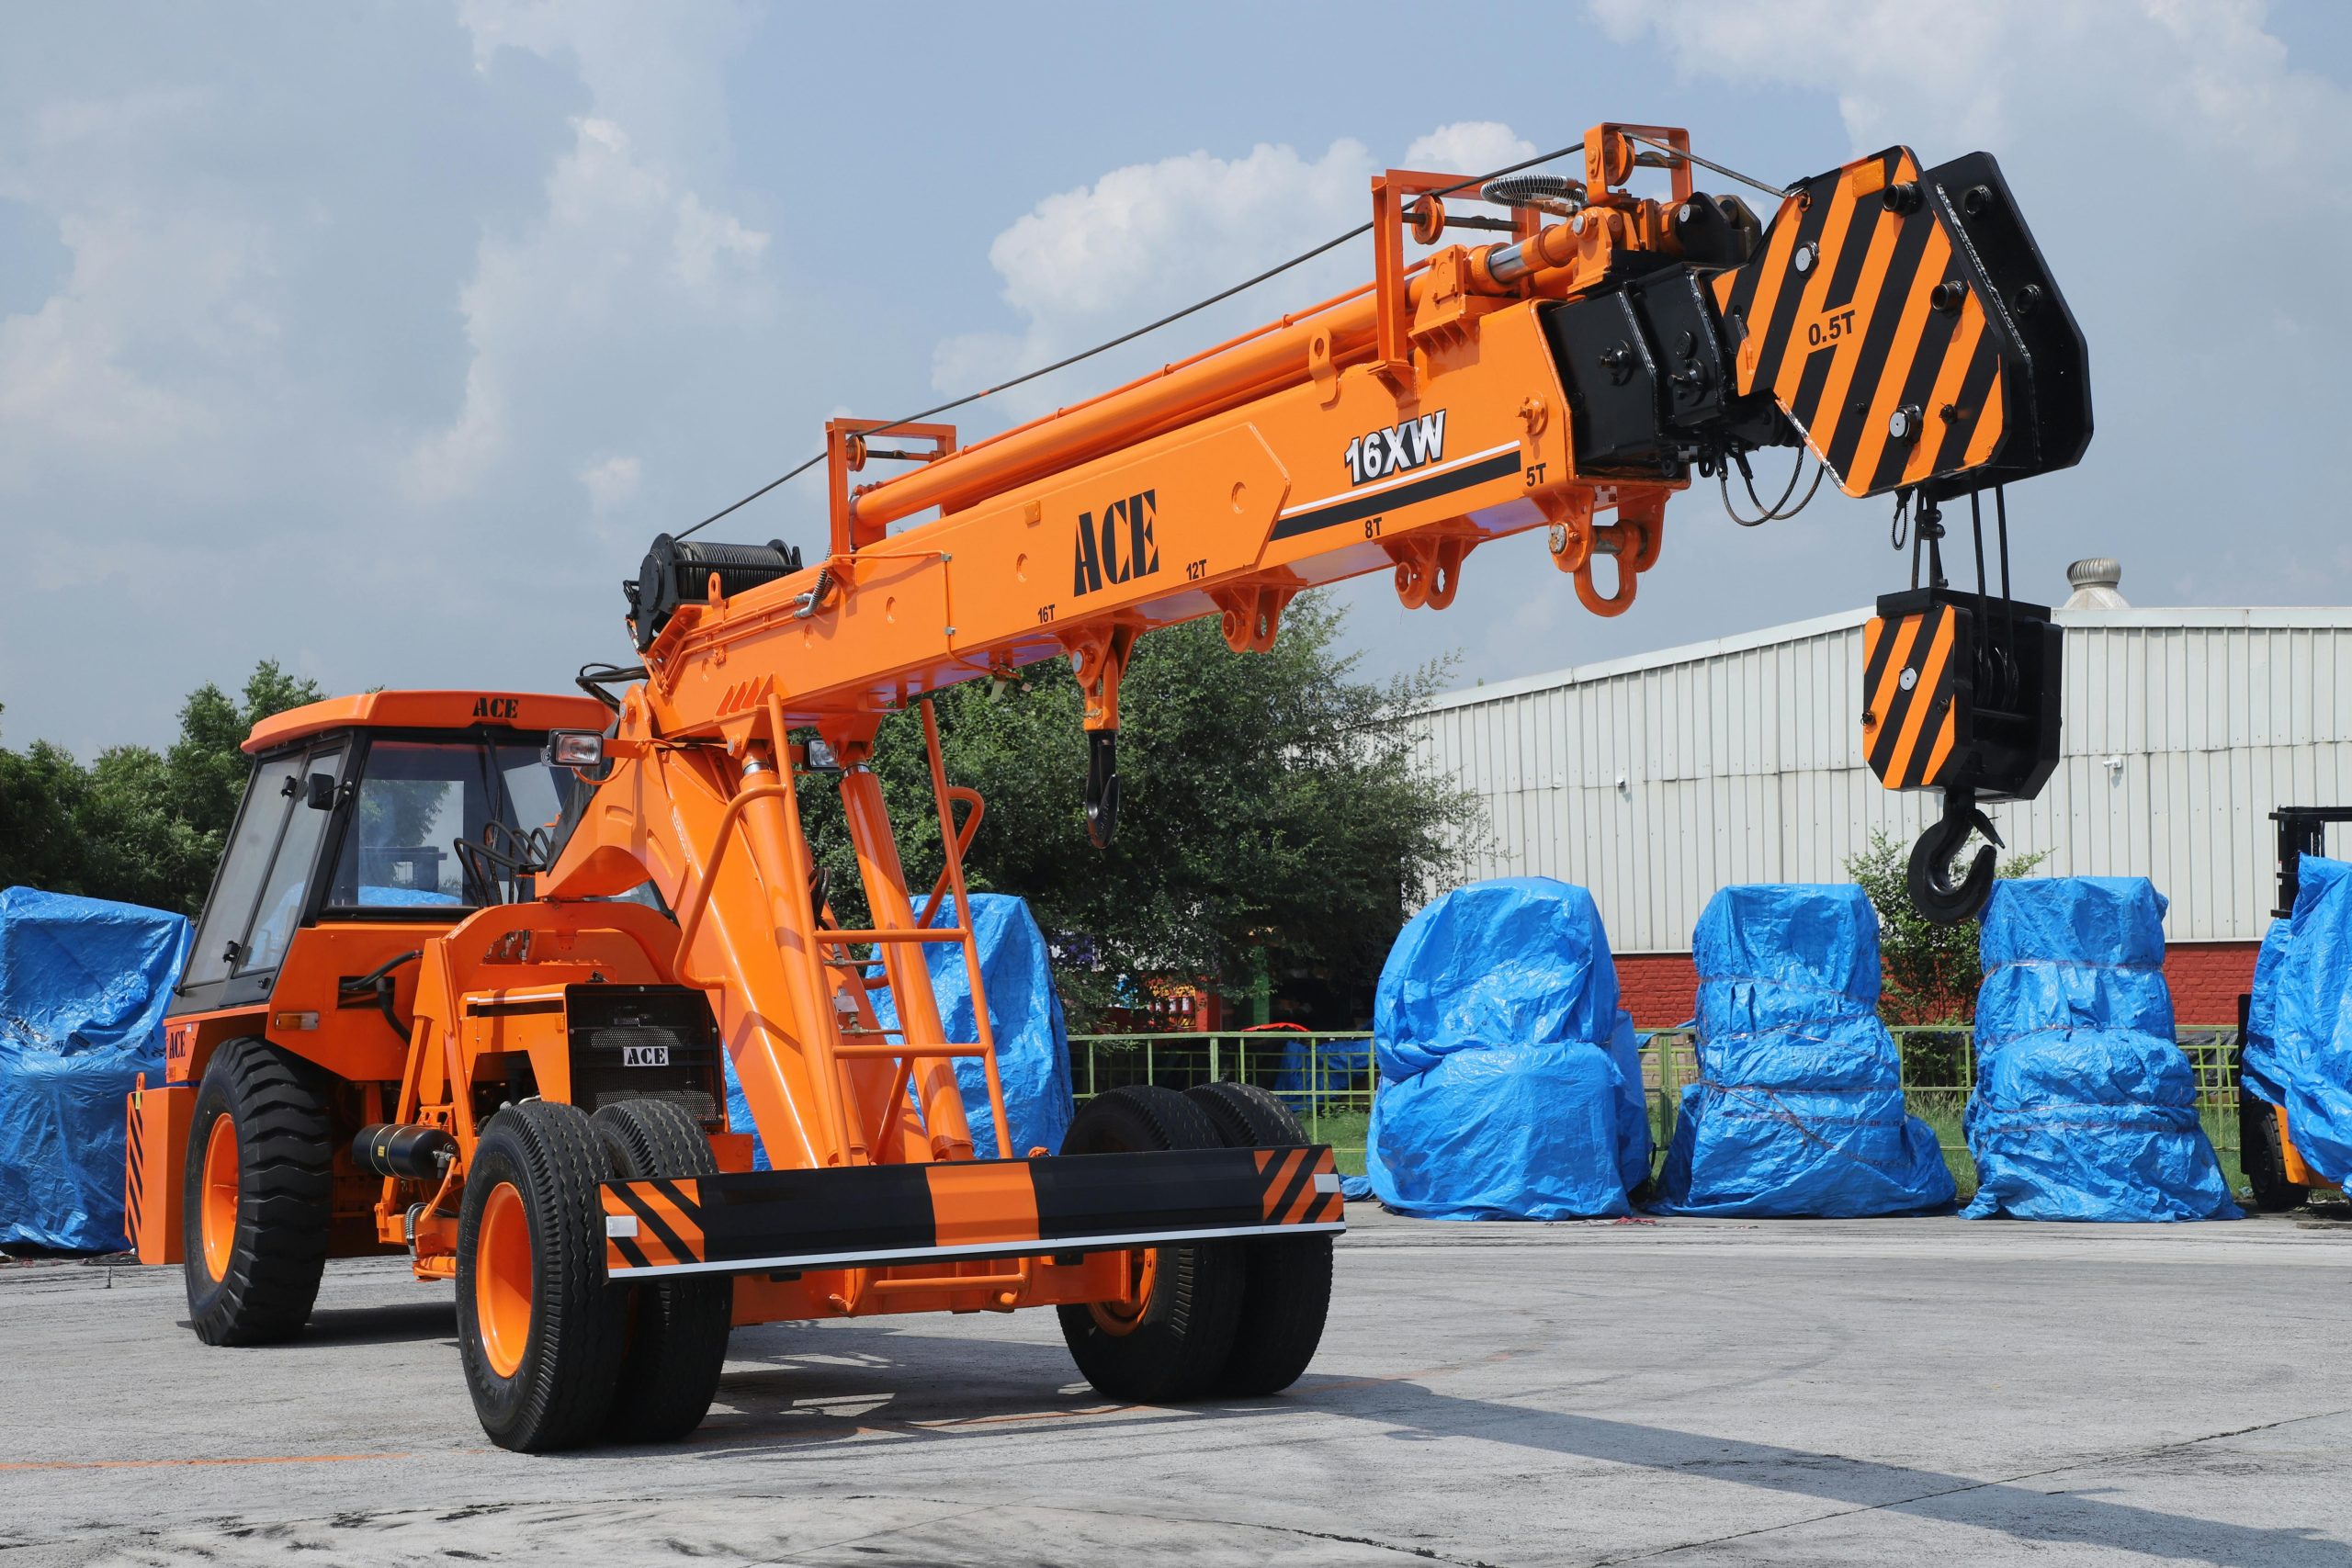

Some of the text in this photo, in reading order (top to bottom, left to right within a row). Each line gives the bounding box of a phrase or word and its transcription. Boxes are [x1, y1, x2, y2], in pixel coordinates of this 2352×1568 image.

[1808, 310, 1855, 346] 0.5T
[1344, 408, 1446, 487] 16XW
[1526, 463, 1546, 487] 5T
[1364, 517, 1382, 539] 8T
[1074, 489, 1159, 597] ACE
[1186, 558, 1207, 581] 12T
[1037, 604, 1055, 624] 16T
[472, 697, 519, 719] ACE
[168, 1030, 186, 1059] ACE
[627, 1047, 666, 1065] ACE
